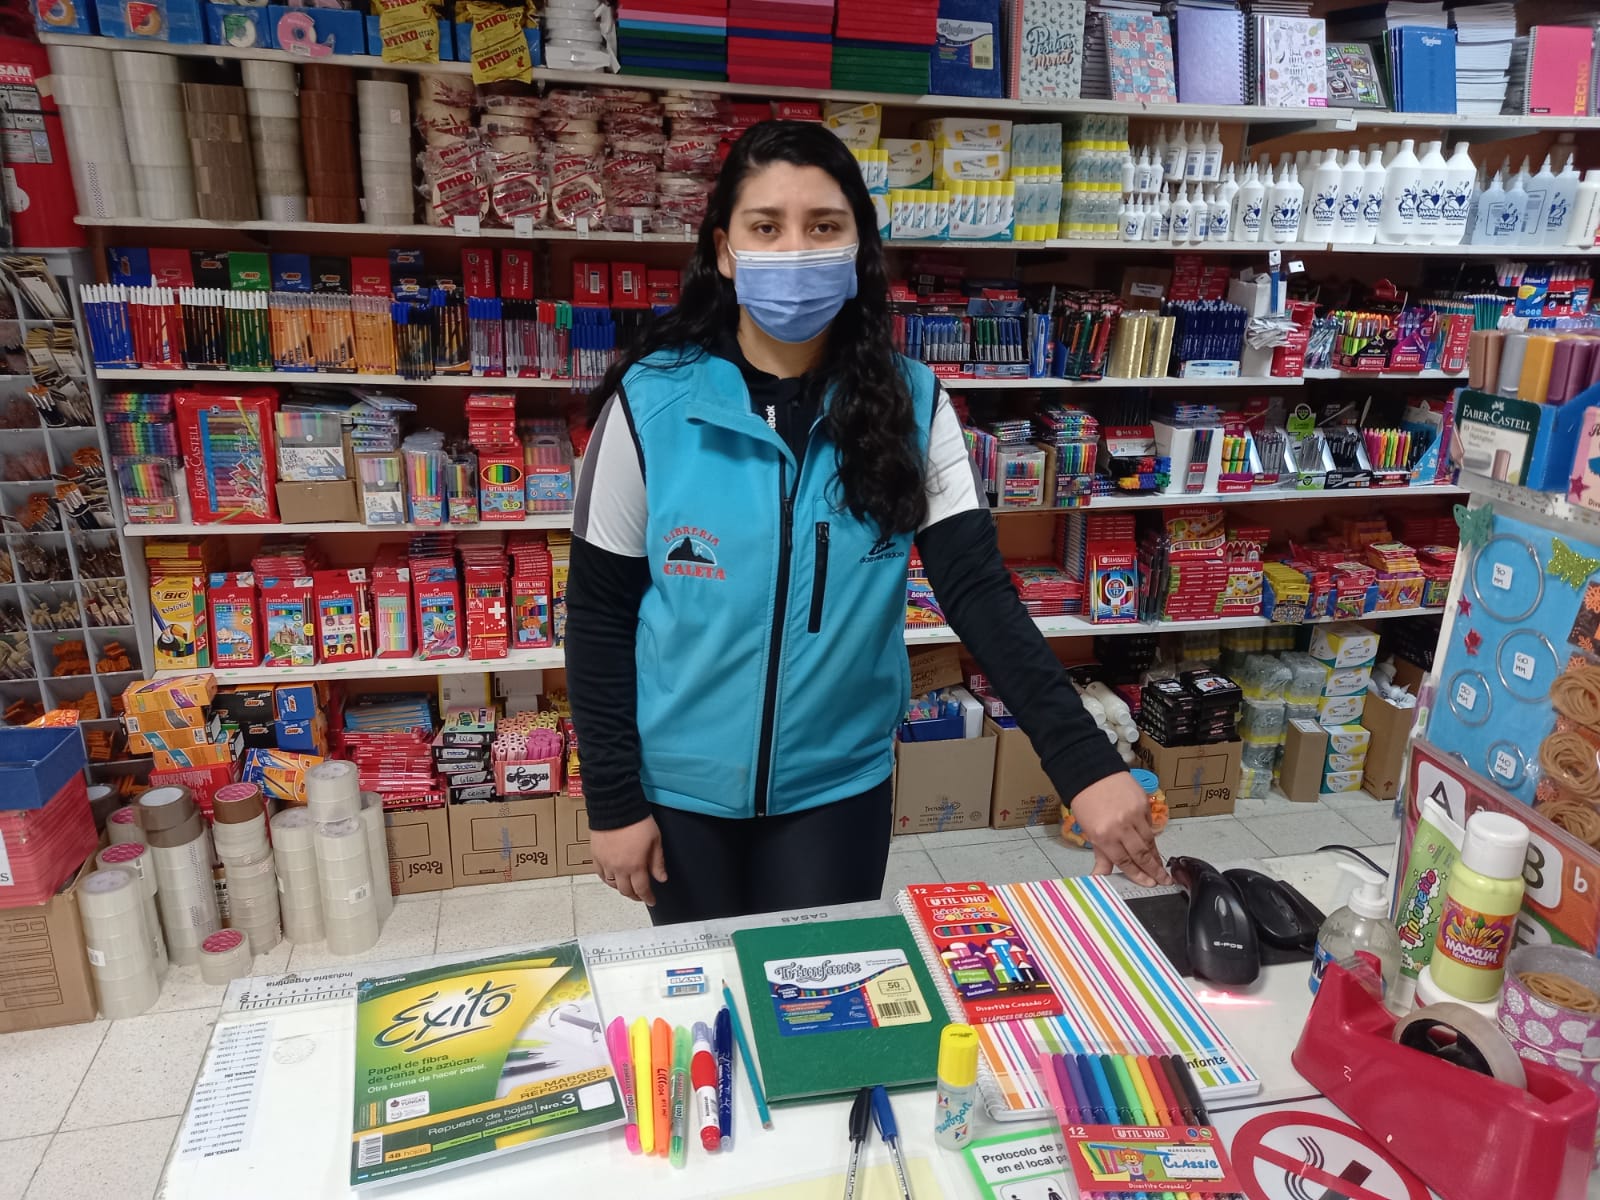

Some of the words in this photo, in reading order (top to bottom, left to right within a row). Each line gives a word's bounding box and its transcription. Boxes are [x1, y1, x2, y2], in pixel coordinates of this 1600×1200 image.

[1574, 60, 1588, 115] TECNO
[766, 404, 777, 432] ebok
[663, 526, 720, 546] LIBRERIA
[663, 563, 726, 580] CALETA
[163, 592, 187, 600] BIC
[1430, 780, 1454, 821] A
[1522, 841, 1545, 890] B
[1573, 866, 1588, 893] b
[960, 895, 986, 904] UNO
[781, 912, 828, 923] CASAS
[1445, 937, 1498, 964] MAXXUM
[313, 971, 353, 981] Industria
[774, 959, 863, 983] Triunfante
[266, 976, 312, 987] Argentina
[888, 981, 901, 989] 50
[373, 980, 517, 1048] Éxito
[367, 1076, 383, 1085] de
[385, 1070, 416, 1081] caña
[417, 1064, 433, 1074] de
[436, 1055, 478, 1070] azúcar.
[368, 1063, 402, 1077] Papel
[404, 1060, 419, 1069] de
[422, 1054, 449, 1066] fibra
[1186, 1053, 1228, 1071] nfante
[367, 1085, 388, 1094] Otra
[390, 1079, 417, 1089] forma
[418, 1074, 431, 1082] de
[432, 1069, 458, 1080] hacer
[460, 1063, 487, 1075] papel.
[520, 1071, 608, 1100] REFORZADO
[543, 1067, 607, 1088] MARGEN
[428, 1116, 484, 1136] Repuesto
[486, 1109, 501, 1121] de
[503, 1103, 534, 1118] hojas
[540, 1103, 562, 1113] Nro.
[562, 1093, 576, 1106] 3
[485, 1117, 505, 1128] para
[506, 1110, 535, 1124] carpeta
[1068, 1127, 1086, 1135] 12
[1144, 1129, 1165, 1139] UNO
[388, 1152, 401, 1160] 48
[403, 1146, 429, 1158] hojas
[982, 1147, 1038, 1164] Protocolo
[1039, 1142, 1055, 1153] de
[997, 1164, 1012, 1174] en
[1015, 1160, 1024, 1171] el
[1027, 1155, 1055, 1169] local
